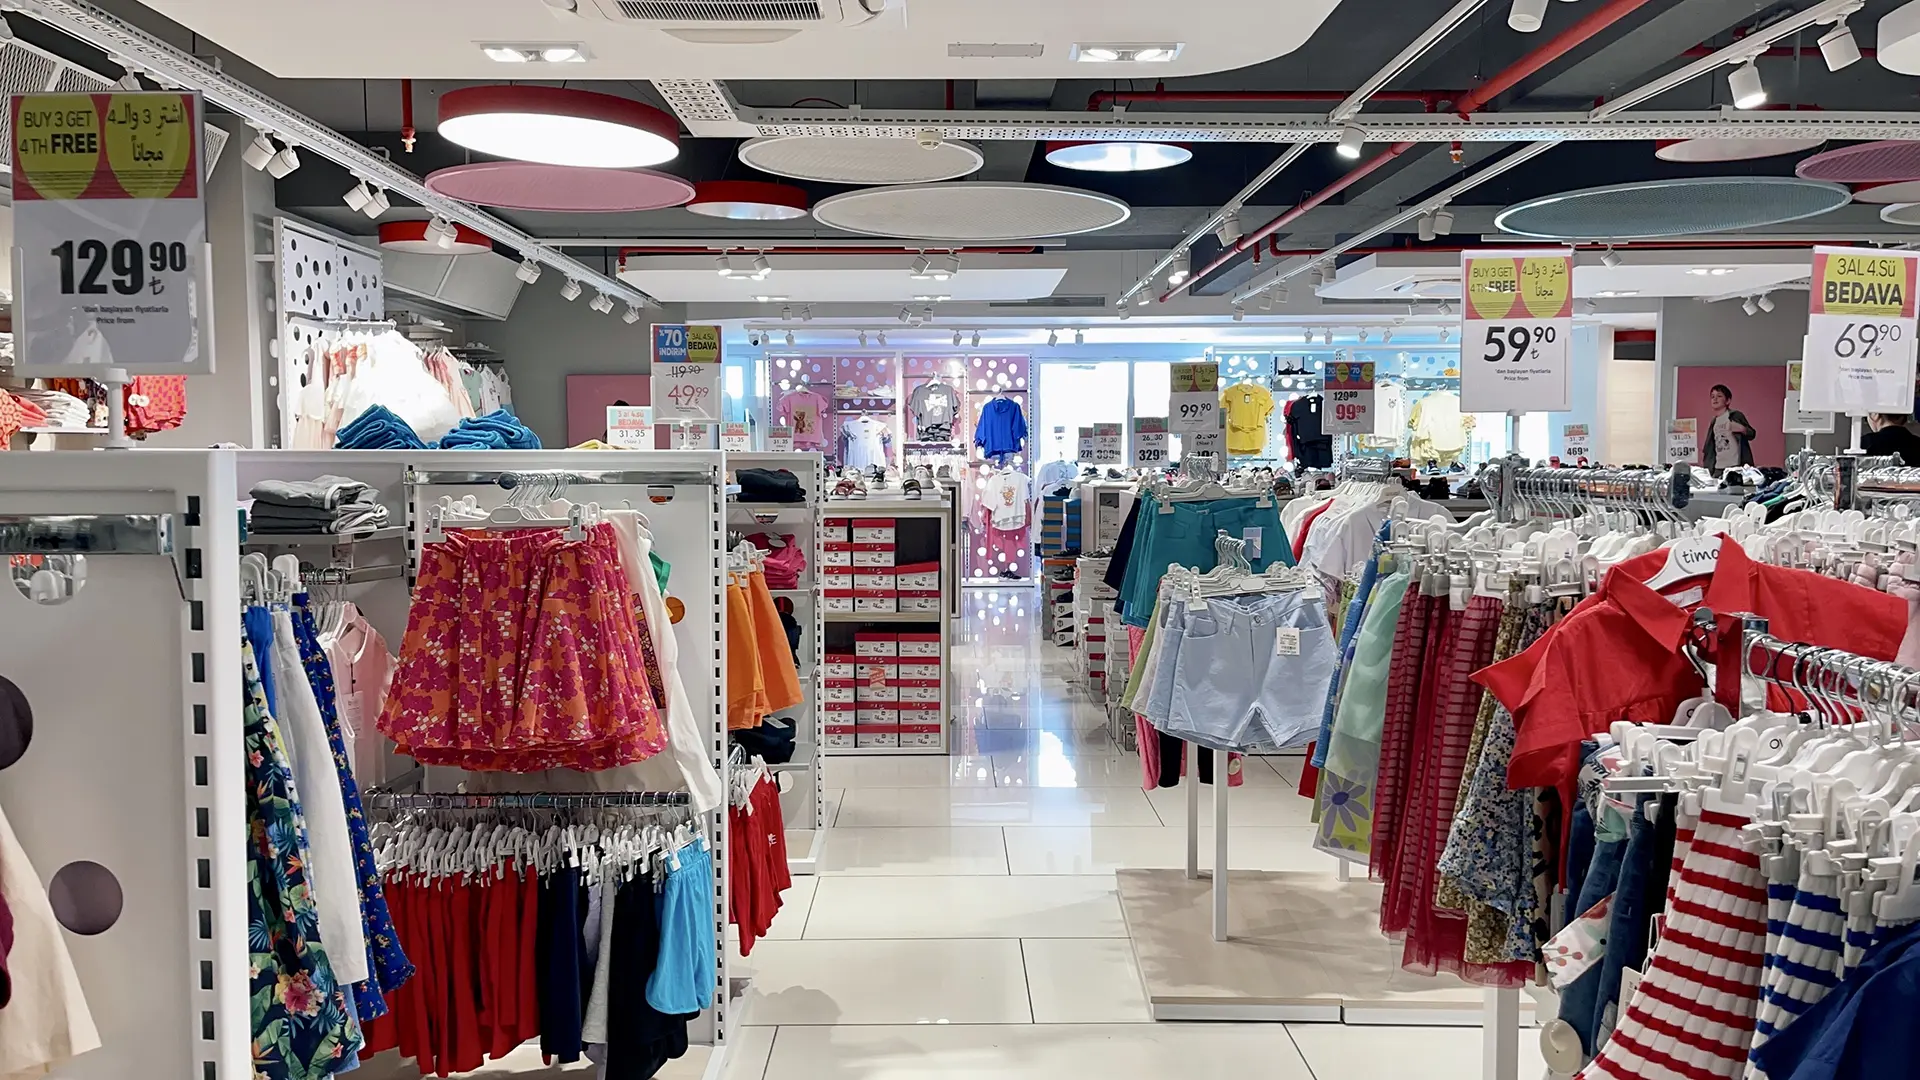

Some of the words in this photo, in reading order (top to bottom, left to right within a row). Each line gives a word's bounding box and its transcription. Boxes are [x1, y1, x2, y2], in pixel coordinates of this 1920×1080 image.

[24, 112, 51, 128] BUY
[54, 112, 64, 127] 3
[67, 111, 92, 127] GET
[51, 133, 98, 154] FREE
[51, 239, 144, 295] 129
[150, 241, 187, 272] 90
[1473, 268, 1489, 278] BUY
[1491, 267, 1496, 277] 3
[1498, 266, 1513, 277] GET
[1488, 280, 1516, 293] FREE
[1825, 280, 1903, 306] BEDAVA
[688, 341, 718, 350] BEDAVA
[1484, 326, 1531, 362] 59
[1534, 326, 1556, 343] 90
[1834, 323, 1878, 359] 69
[1879, 324, 1901, 342] 90
[1139, 449, 1159, 461] 329
[1567, 447, 1583, 456] 469
